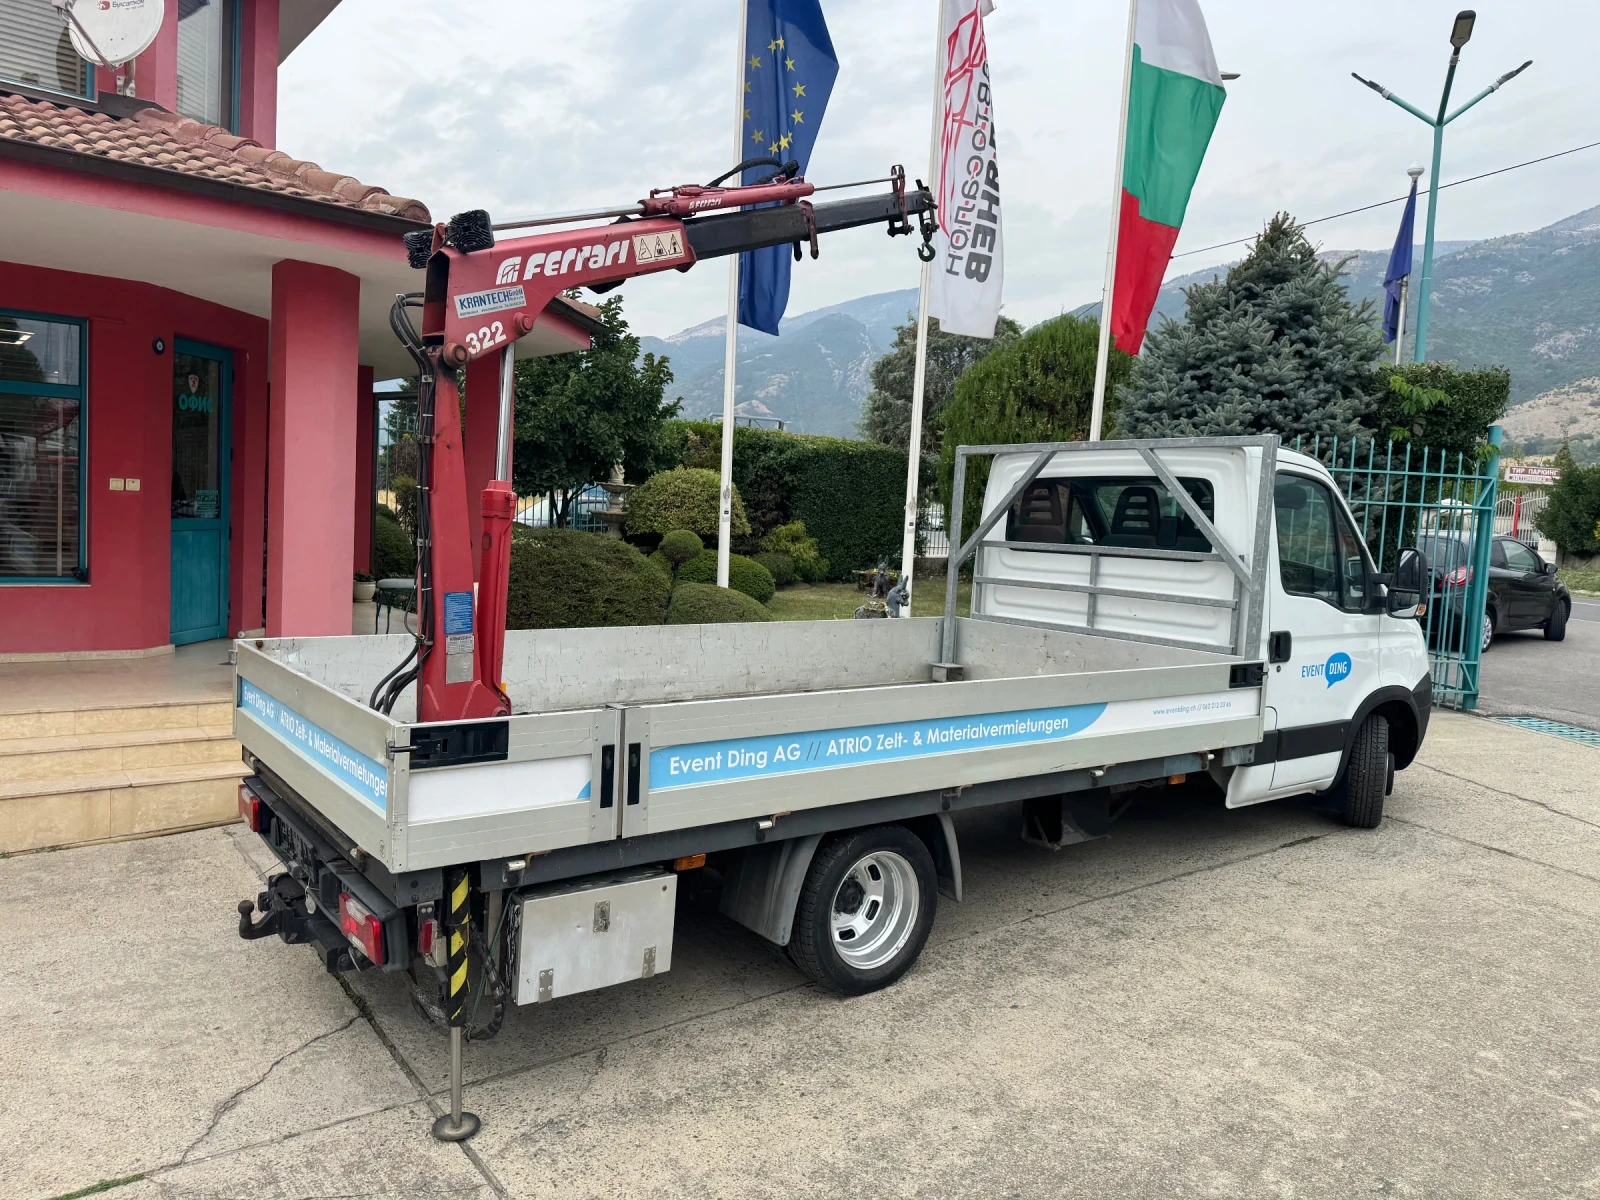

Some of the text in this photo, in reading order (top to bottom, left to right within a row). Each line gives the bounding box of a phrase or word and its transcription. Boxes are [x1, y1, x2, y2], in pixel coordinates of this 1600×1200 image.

[523, 239, 630, 281] Ferrari
[459, 290, 510, 310] KRANTECH
[465, 321, 507, 355] 322
[178, 394, 214, 414] ОФИС
[1528, 468, 1559, 476] ПАРКИНГ
[1301, 661, 1348, 678] EVENT DING
[244, 685, 256, 707] Event
[255, 693, 266, 716] Ding
[266, 703, 275, 719] AG
[281, 709, 295, 734] ATRIO
[670, 751, 723, 775] Event
[727, 749, 768, 769] Ding
[773, 743, 801, 763] AG
[826, 735, 872, 757] ATRIO
[877, 731, 908, 751] Zelt-
[913, 731, 923, 747] &
[926, 717, 1069, 745] Materialvermietungen
